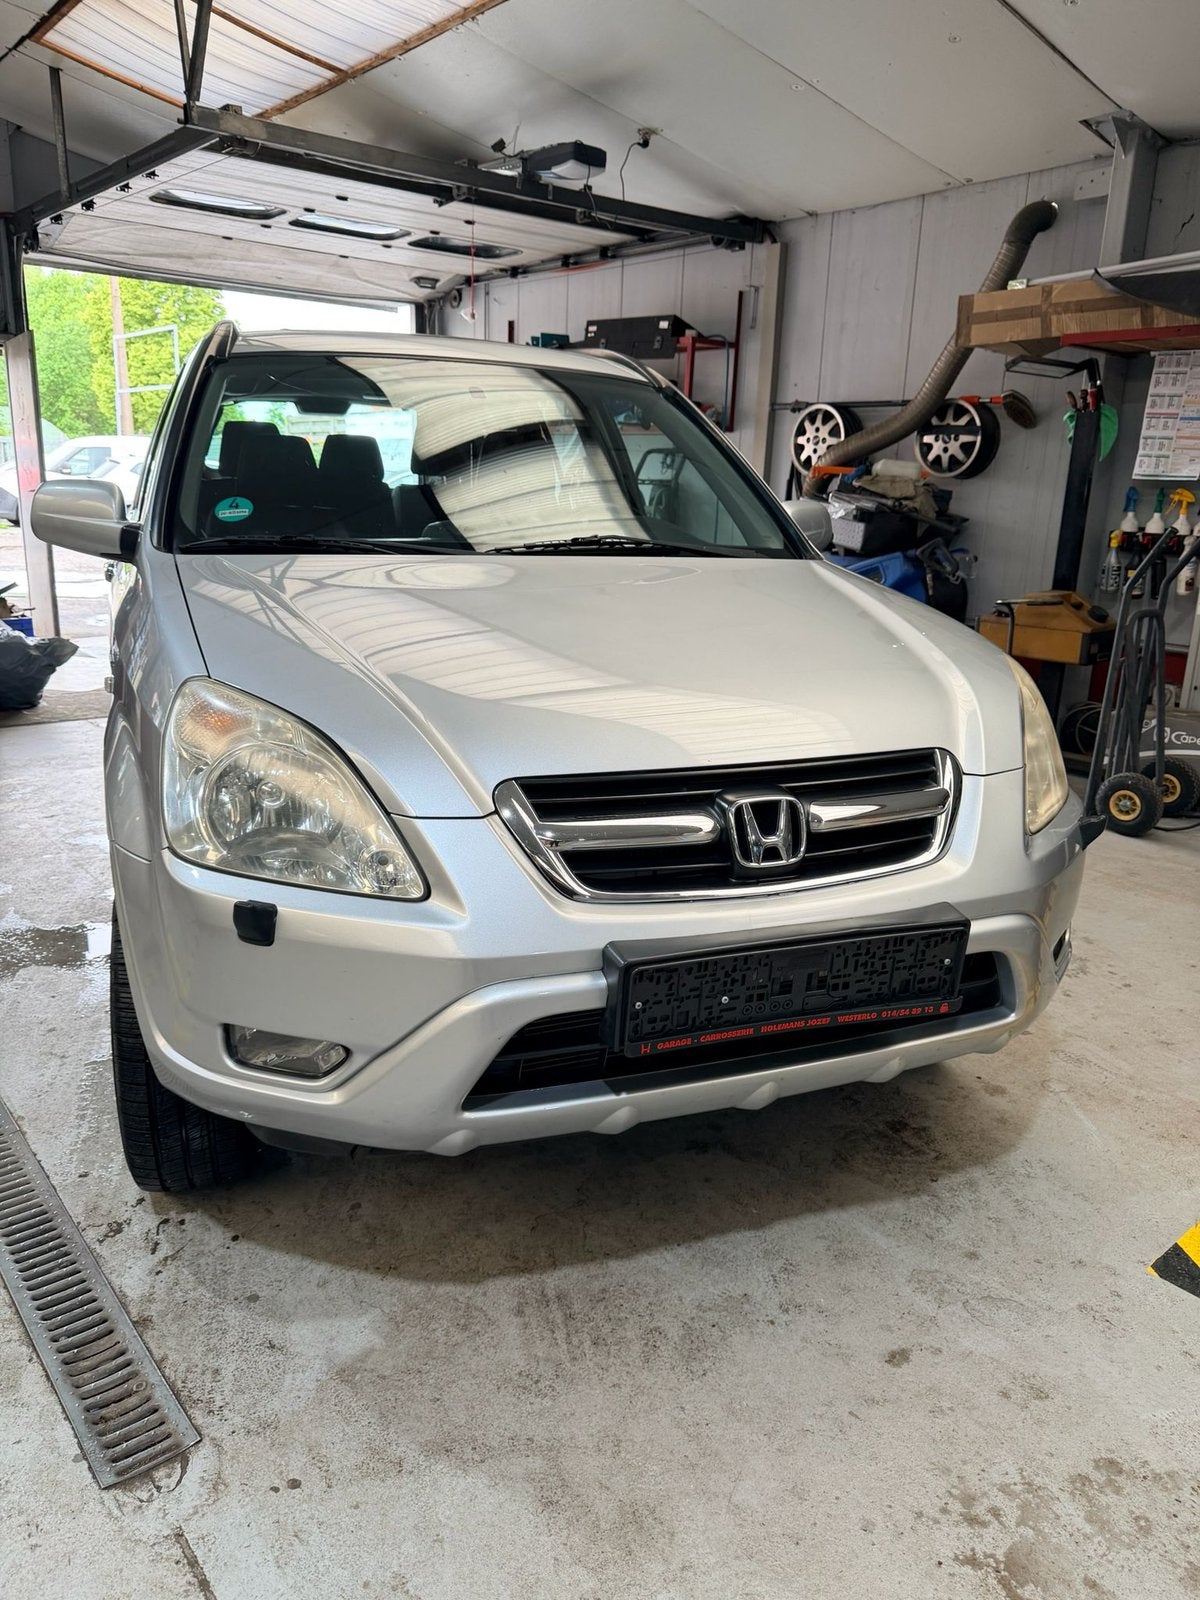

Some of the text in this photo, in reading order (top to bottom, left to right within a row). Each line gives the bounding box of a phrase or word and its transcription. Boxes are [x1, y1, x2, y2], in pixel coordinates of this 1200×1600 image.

[229, 498, 239, 509] 4
[657, 1038, 692, 1050] GARAGE
[700, 1028, 754, 1043] CARROSSERIE
[760, 1021, 806, 1033] HOLEMANS
[806, 1017, 831, 1027] JOZEF
[837, 1012, 878, 1023] WESTERLO
